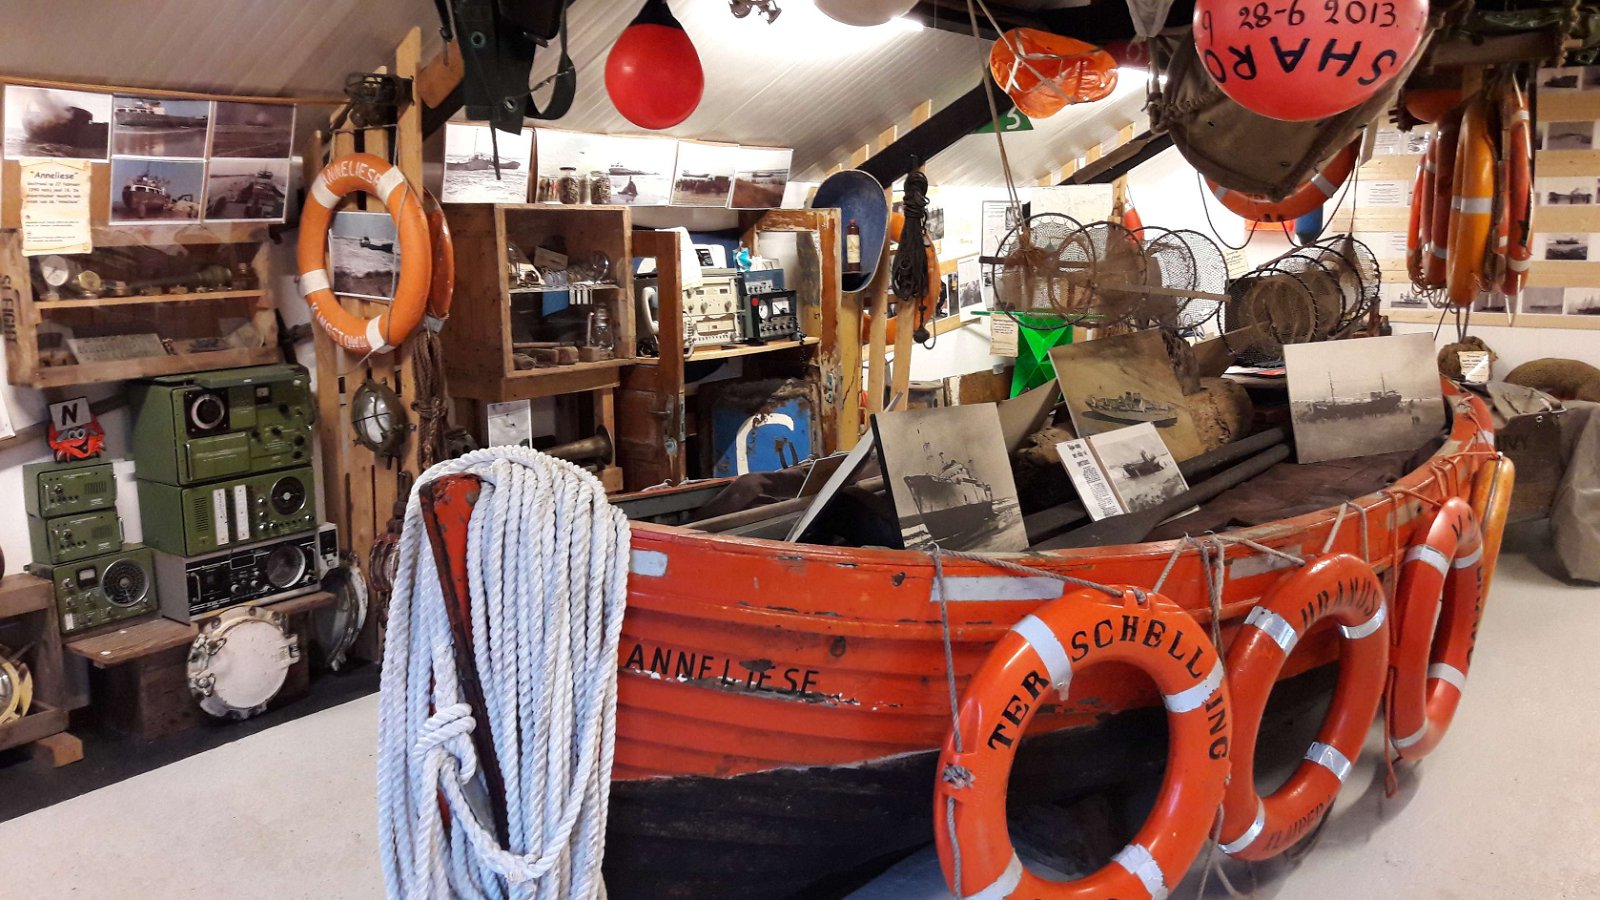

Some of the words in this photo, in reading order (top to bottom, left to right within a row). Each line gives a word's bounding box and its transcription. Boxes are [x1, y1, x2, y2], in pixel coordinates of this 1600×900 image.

[1238, 0, 1305, 31] 28-6
[62, 403, 78, 426] N
[987, 670, 1050, 751] TER
